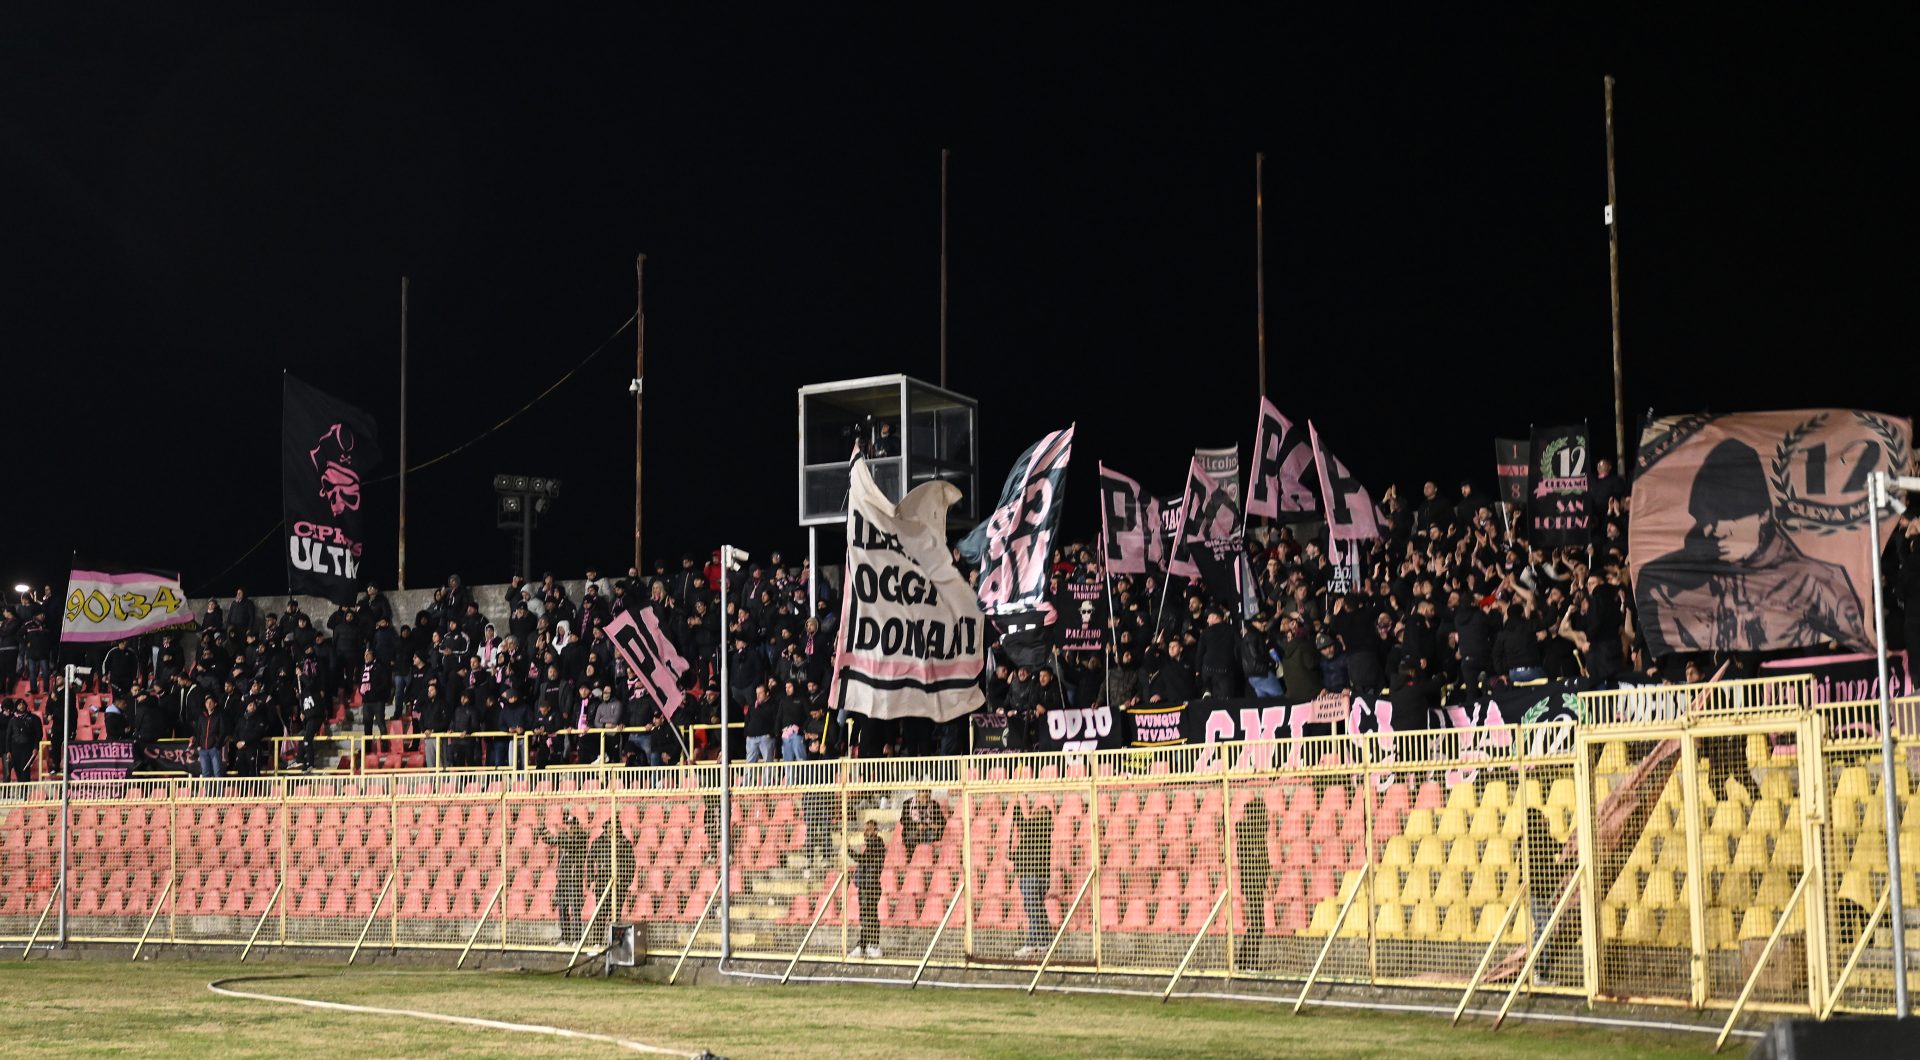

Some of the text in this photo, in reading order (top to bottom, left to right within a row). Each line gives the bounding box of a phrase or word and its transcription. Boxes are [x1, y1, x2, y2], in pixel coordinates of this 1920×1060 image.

[1557, 446, 1586, 478] 12
[1797, 440, 1881, 495] 12
[855, 563, 938, 607] OGGI
[66, 586, 182, 624] 90134
[1065, 627, 1101, 639] PALERMO
[1046, 705, 1113, 740] ODIO
